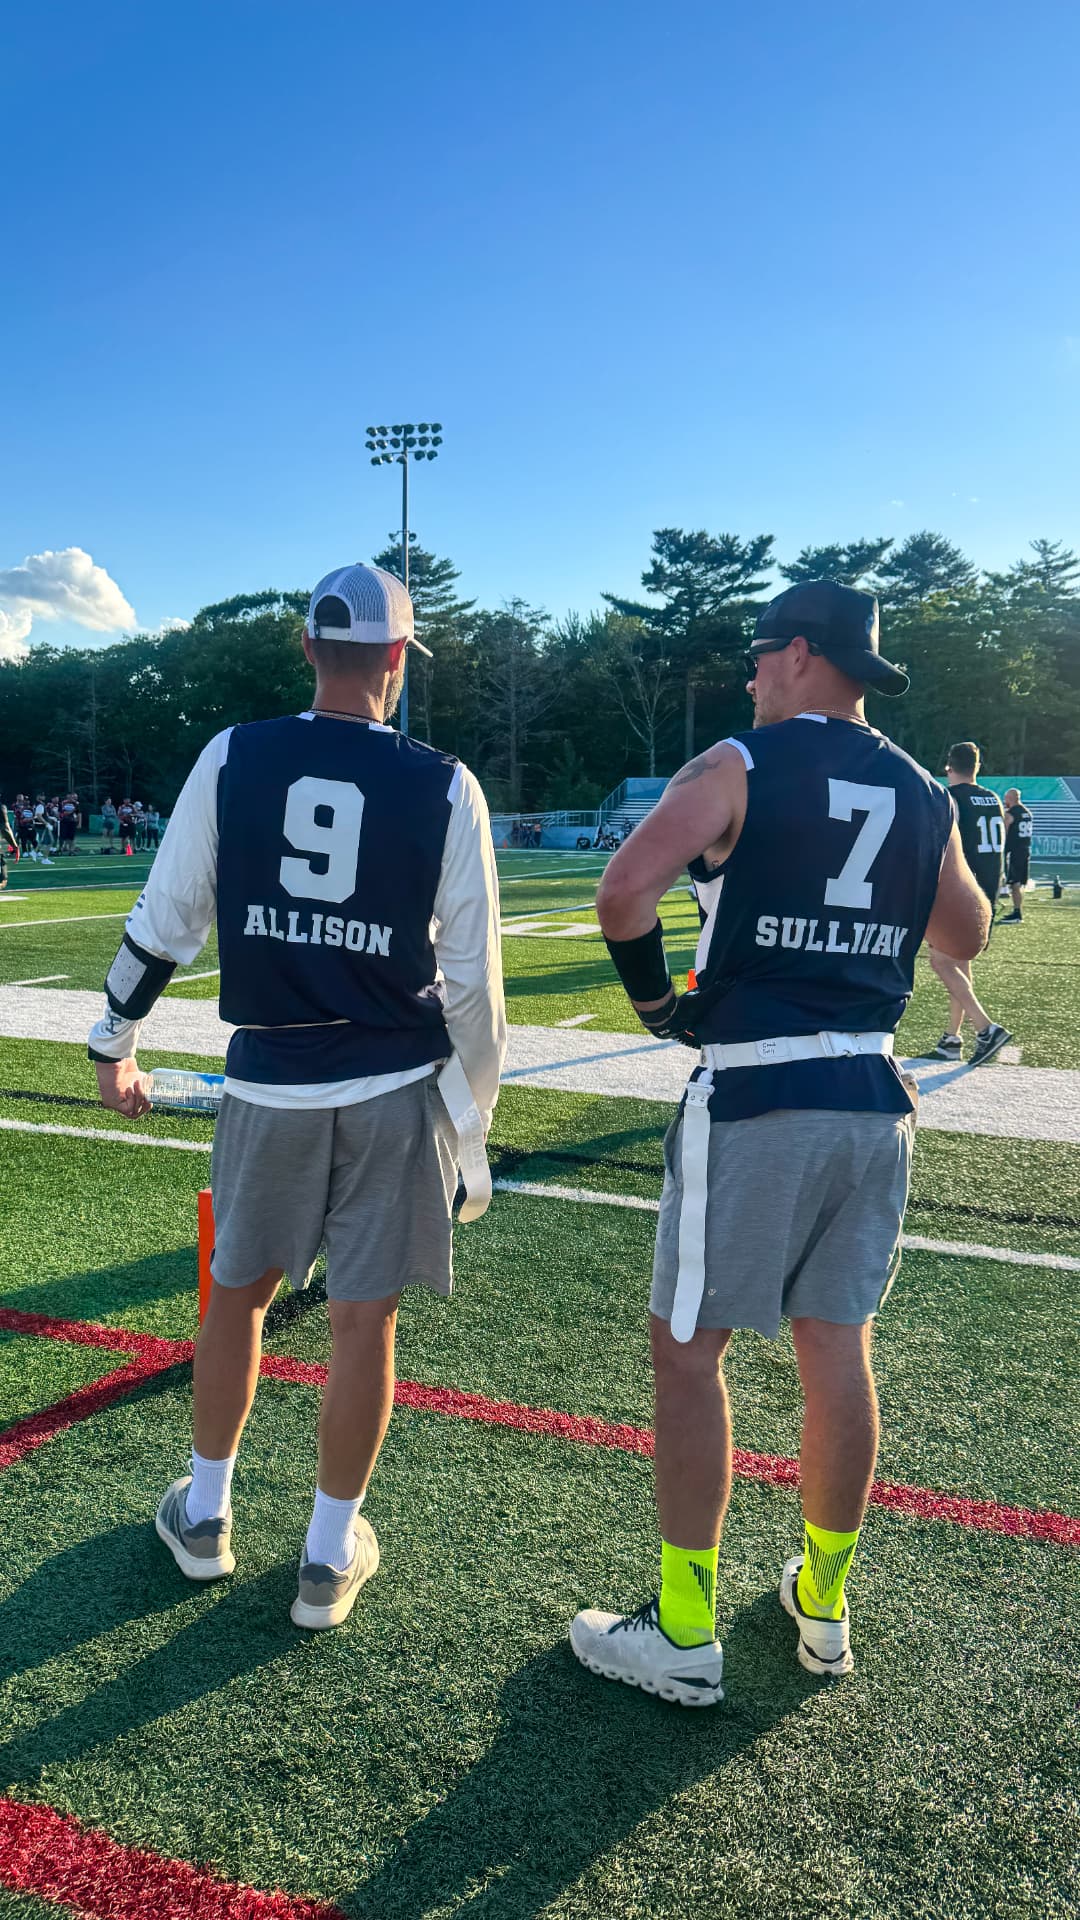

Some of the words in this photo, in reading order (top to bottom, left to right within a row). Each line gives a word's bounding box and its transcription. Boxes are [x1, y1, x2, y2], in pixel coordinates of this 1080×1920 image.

[279, 776, 365, 904] 9
[824, 778, 895, 909] 7
[977, 815, 1006, 853] 10
[244, 904, 392, 956] ALLISON
